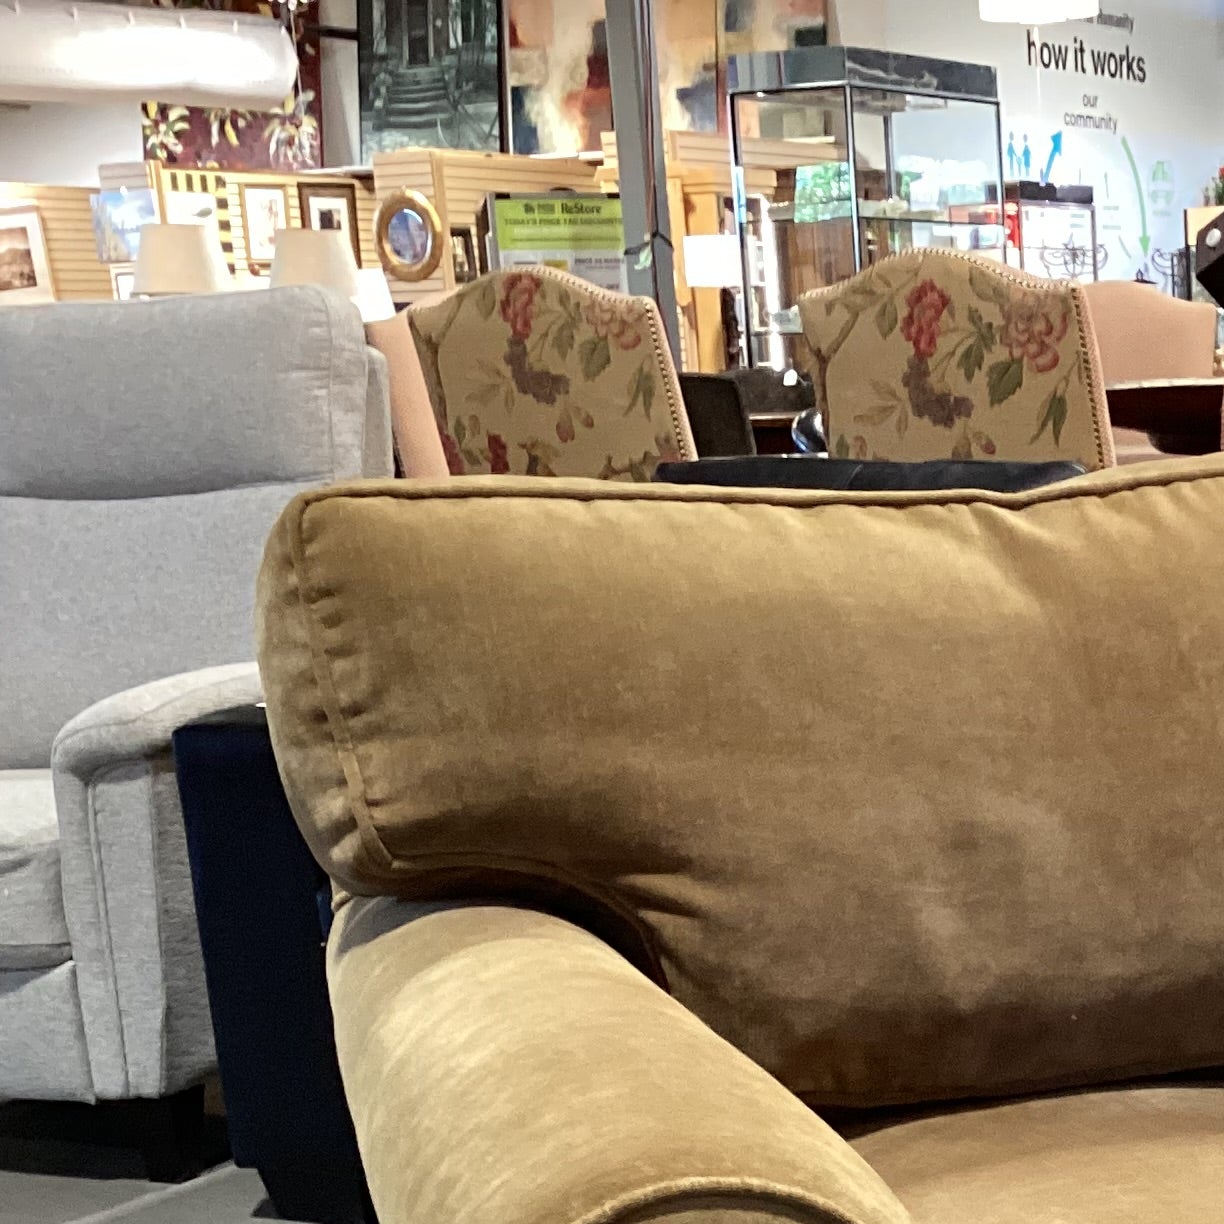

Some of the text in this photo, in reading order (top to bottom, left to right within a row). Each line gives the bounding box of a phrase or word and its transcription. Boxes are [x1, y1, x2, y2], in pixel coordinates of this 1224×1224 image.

[1026, 29, 1146, 83] how it works
[1082, 94, 1098, 108] our
[1063, 112, 1118, 135] community
[561, 202, 602, 214] ReStore
